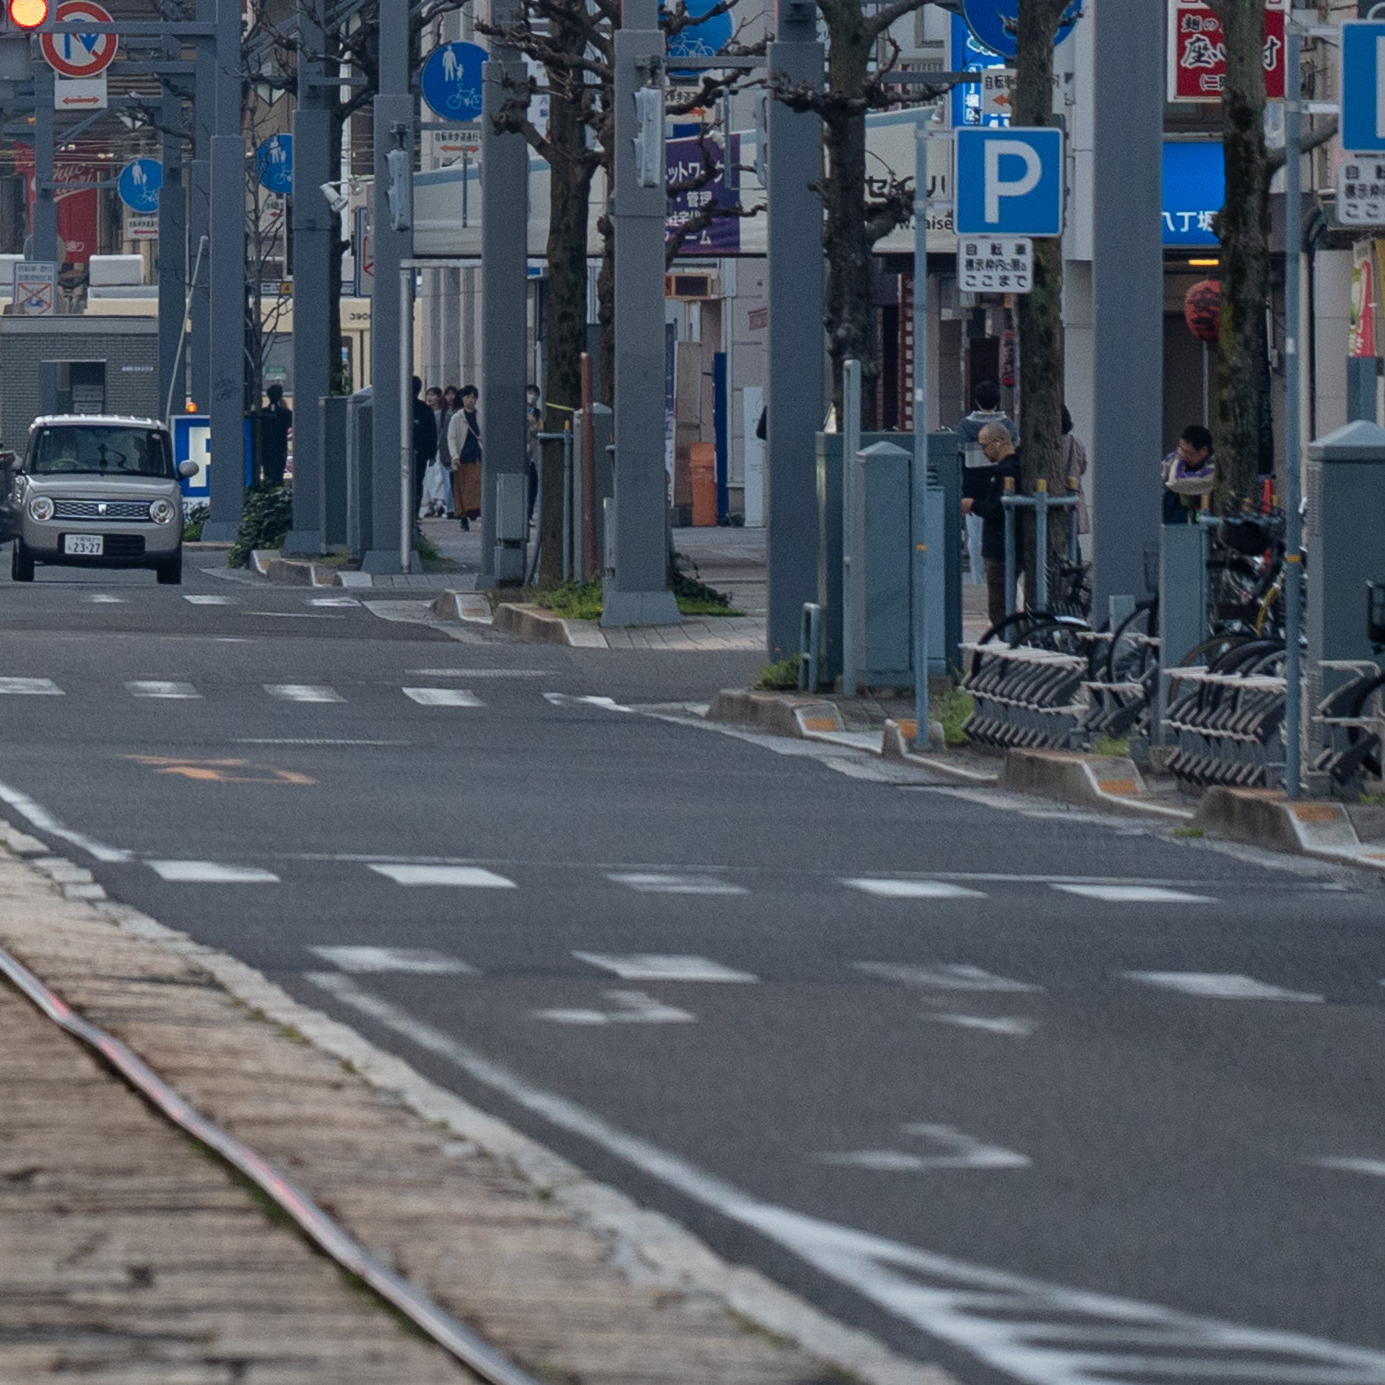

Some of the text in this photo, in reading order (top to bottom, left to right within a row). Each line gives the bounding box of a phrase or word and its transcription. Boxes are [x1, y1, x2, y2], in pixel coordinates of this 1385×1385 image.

[984, 138, 1043, 224] P
[965, 243, 1028, 256] 自転車
[965, 274, 1028, 288] ここまで
[73, 542, 101, 553] 23-27
